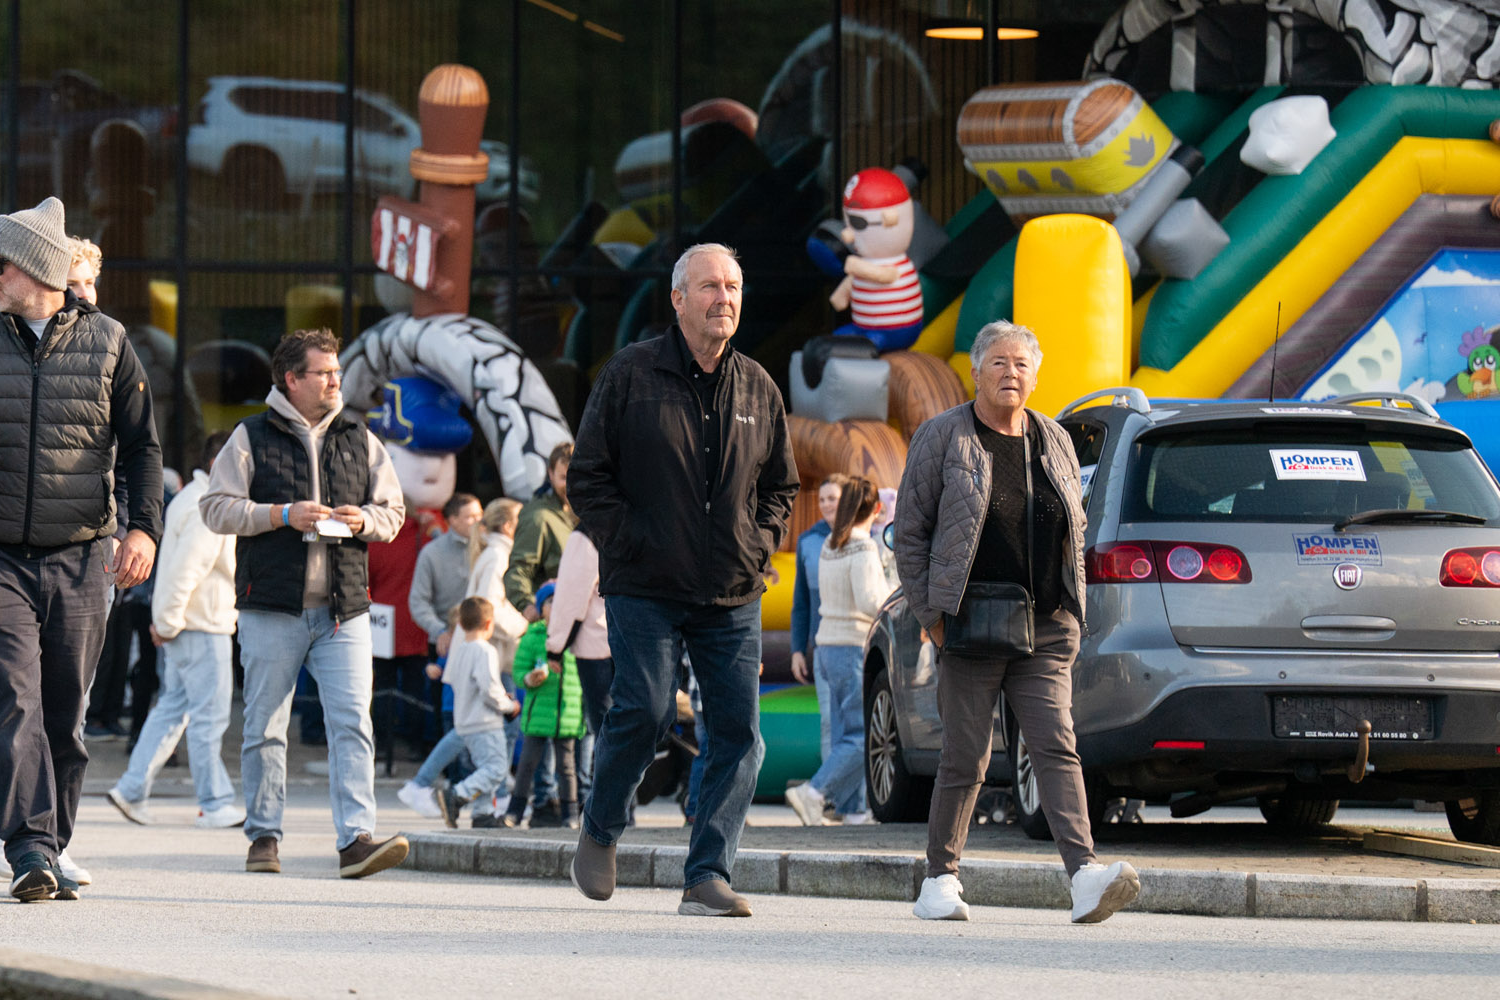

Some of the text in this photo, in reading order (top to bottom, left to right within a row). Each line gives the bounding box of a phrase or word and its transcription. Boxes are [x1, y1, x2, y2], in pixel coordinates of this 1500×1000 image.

[1280, 455, 1354, 470] HOMPEN
[1297, 535, 1377, 555] HOMPEN
[1340, 569, 1356, 583] FIAT
